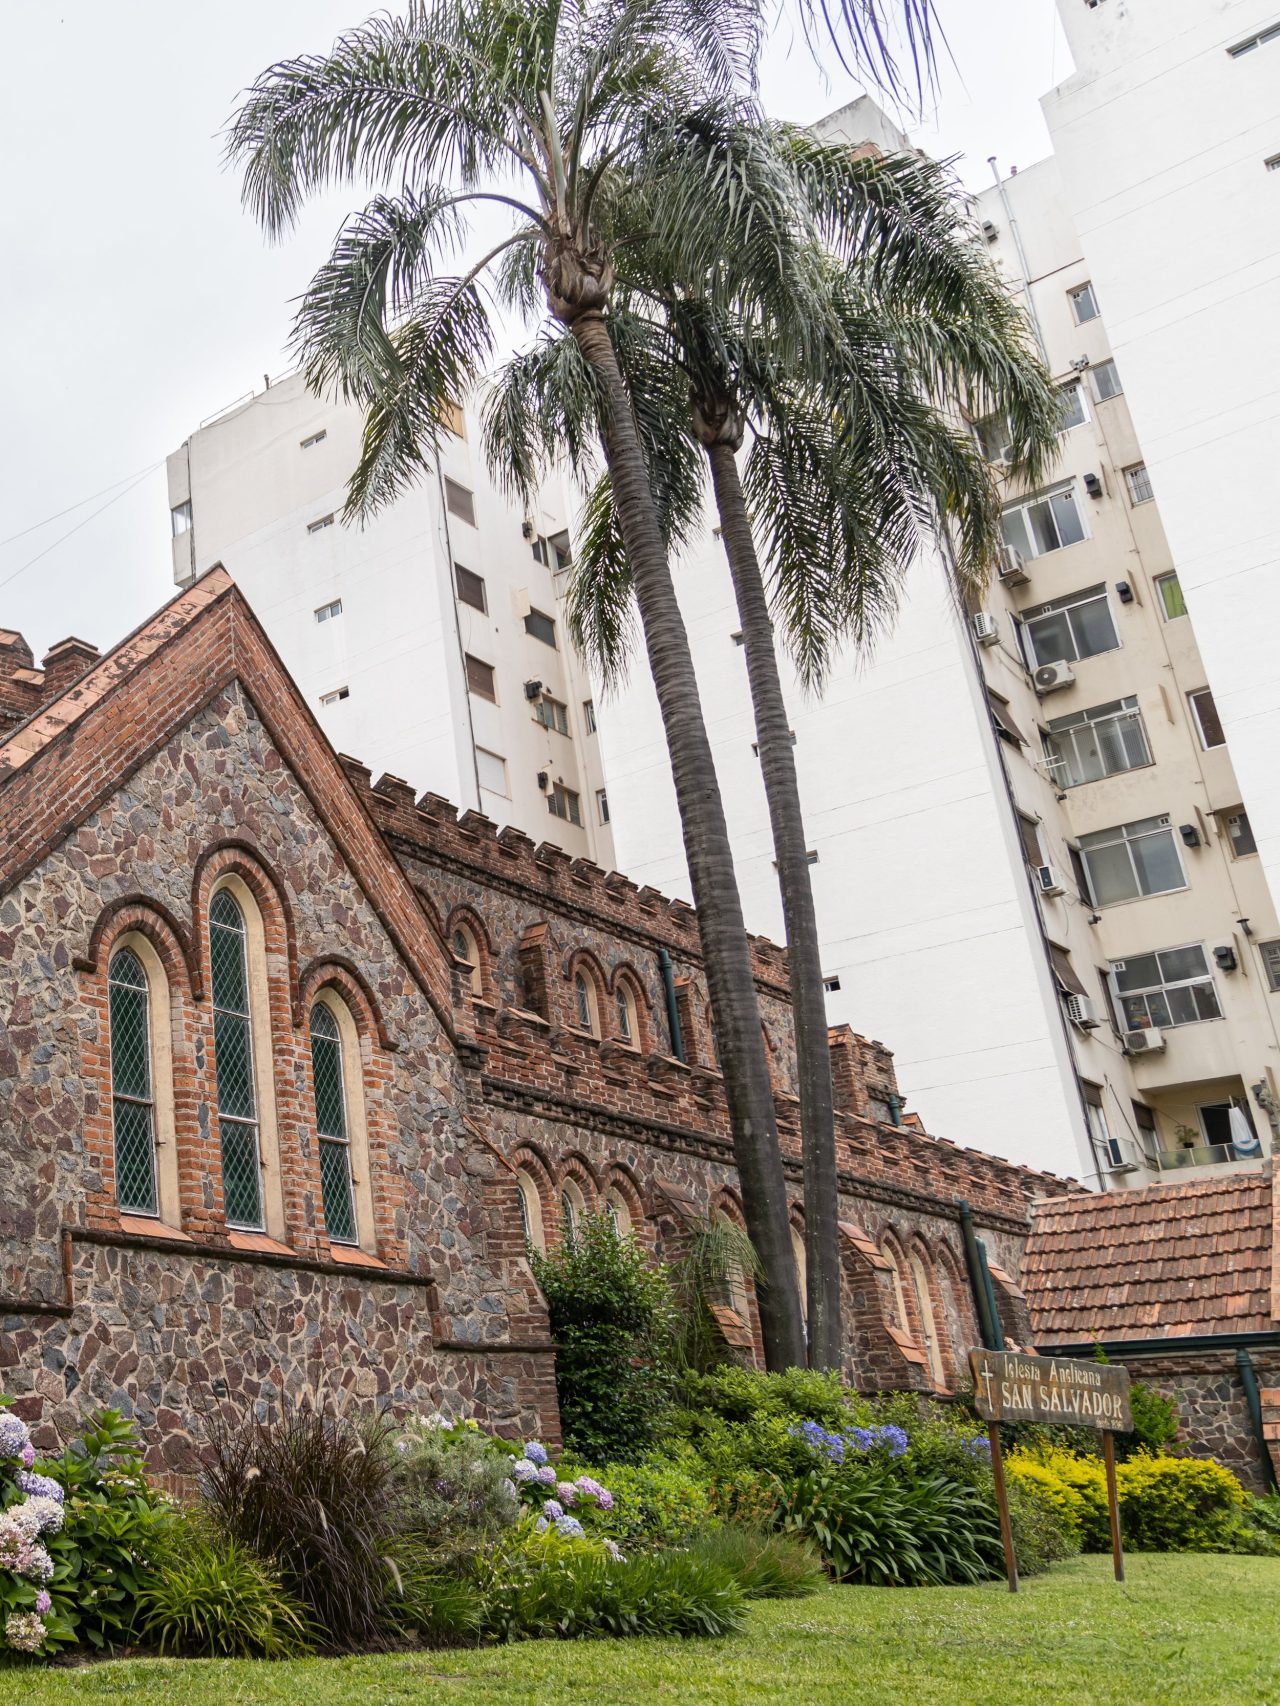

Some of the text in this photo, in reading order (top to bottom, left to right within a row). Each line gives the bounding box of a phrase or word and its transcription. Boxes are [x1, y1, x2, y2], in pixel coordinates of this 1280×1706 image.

[1004, 1354, 1101, 1386] Iglesia Anglicana
[1001, 1382, 1122, 1418] SAN SALVADOR
